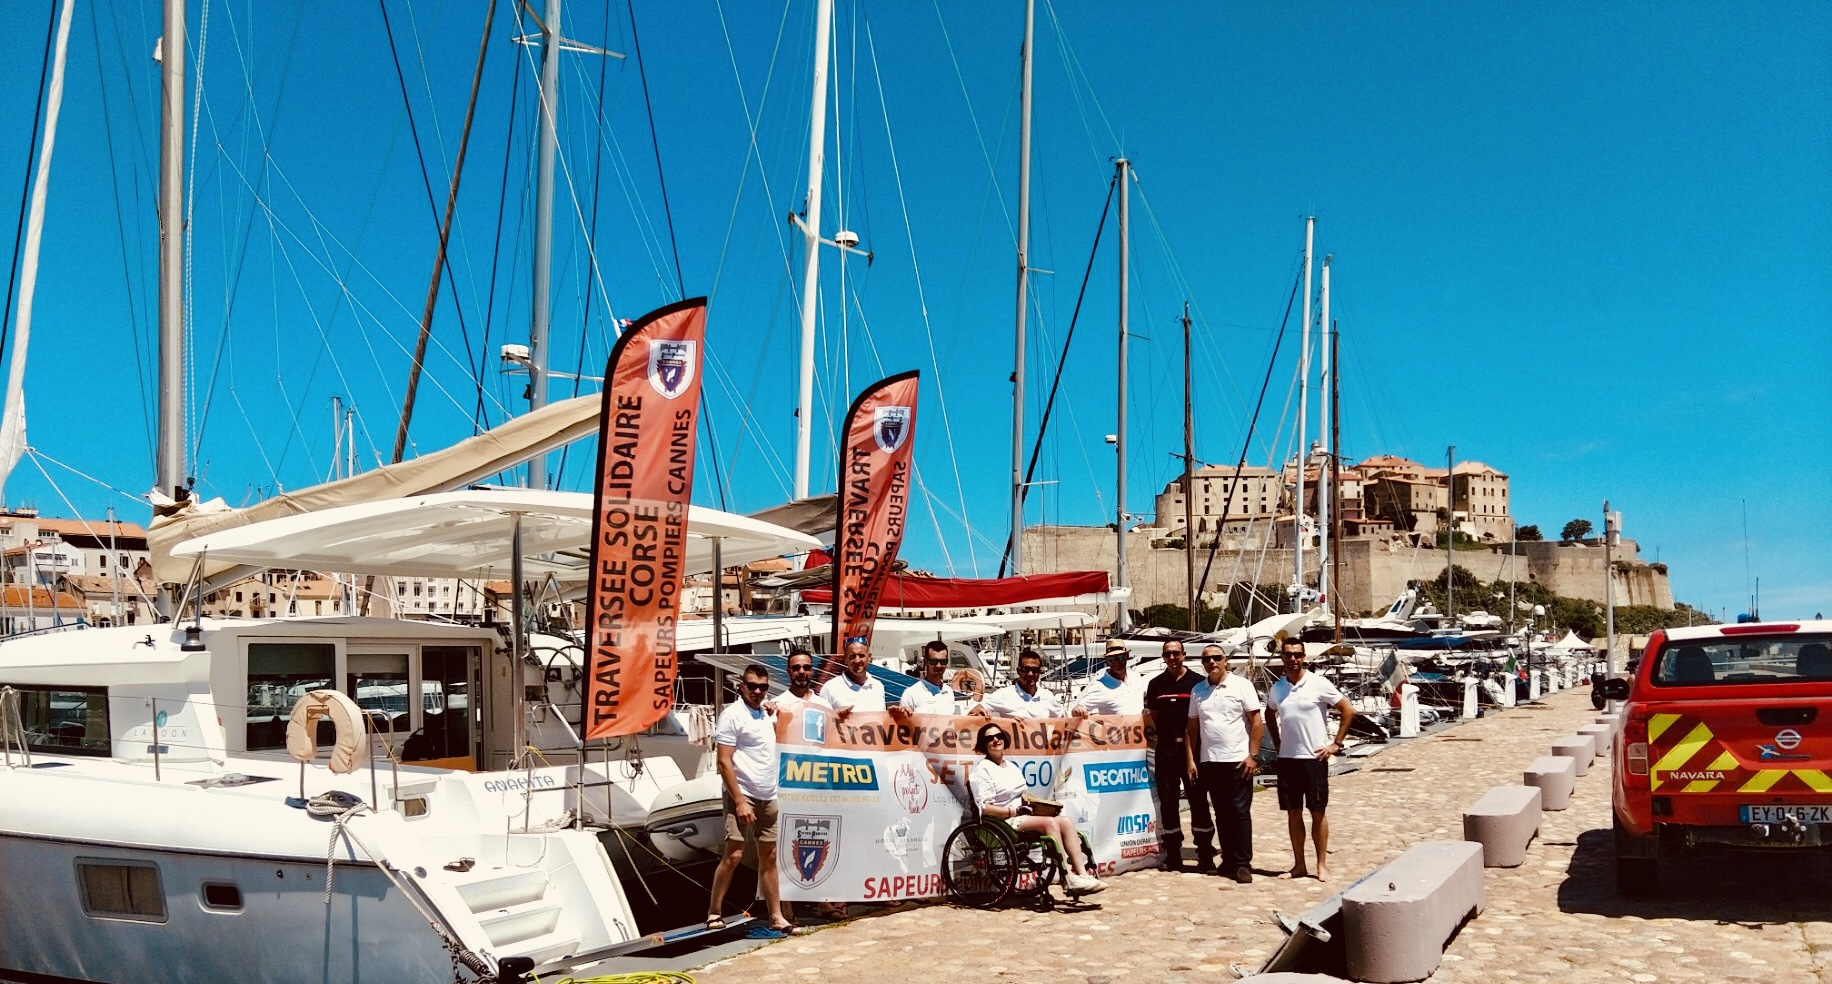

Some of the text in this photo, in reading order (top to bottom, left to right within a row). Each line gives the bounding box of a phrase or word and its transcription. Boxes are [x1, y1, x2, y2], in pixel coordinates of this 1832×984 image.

[594, 395, 642, 726] TRAVERSEE SOLIDAIRE
[629, 505, 659, 607] CORSE
[653, 409, 691, 711] SAPEURS POMPIERS CANNES
[134, 729, 187, 738] LAOON
[786, 760, 874, 785] METRO
[1089, 766, 1150, 787] DECATHLO
[1670, 771, 1726, 780] NAVARA
